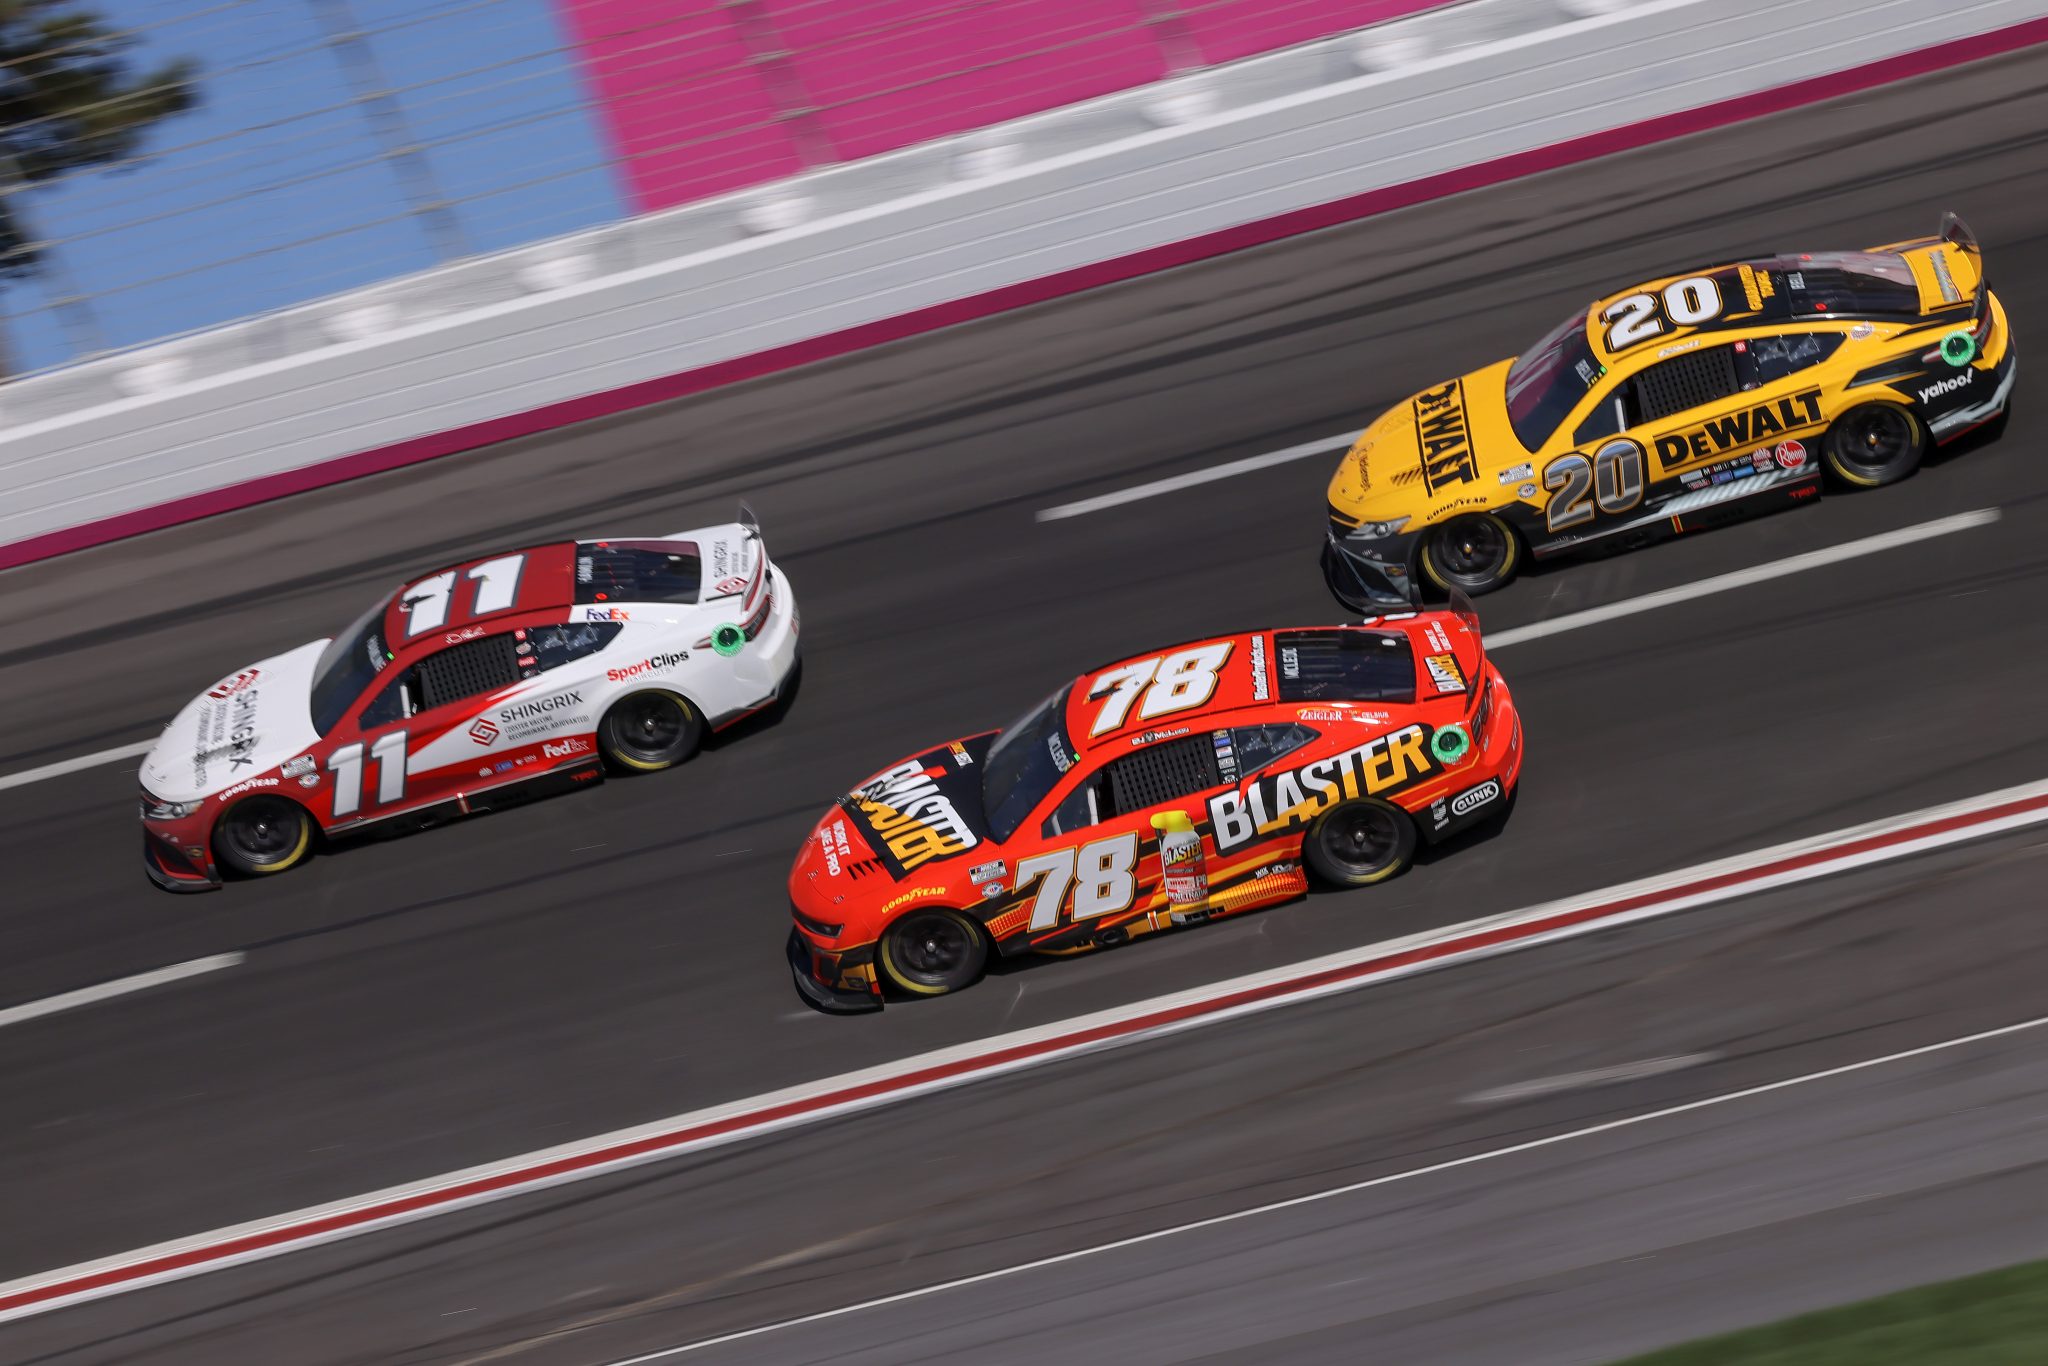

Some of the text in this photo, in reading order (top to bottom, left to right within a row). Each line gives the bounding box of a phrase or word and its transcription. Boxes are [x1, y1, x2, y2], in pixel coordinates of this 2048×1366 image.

[1600, 276, 1724, 352] 20
[1918, 368, 1974, 404] yahoo!
[1776, 441, 1806, 466] Rheem
[1543, 437, 1648, 534] 20
[1426, 497, 1488, 521] GOODYEAR
[403, 553, 527, 638] 11
[587, 608, 630, 621] FedEx
[1083, 640, 1236, 738] 78
[500, 691, 584, 723] SHINGRIX
[1300, 709, 1343, 721] ZEIGLER
[542, 738, 590, 758] FedEx
[218, 778, 280, 801] GOODYEAR
[326, 728, 409, 818] 11
[1209, 723, 1432, 850] BLASTER
[850, 758, 977, 871] BLASTER
[1457, 786, 1495, 811] GUNK
[820, 827, 841, 877] LIKE A PRO
[832, 819, 851, 856] WORK IT
[1164, 842, 1202, 867] BLASTER
[1013, 830, 1138, 933] 78
[1255, 867, 1268, 878] WIX
[881, 887, 946, 914] GOODYEAR
